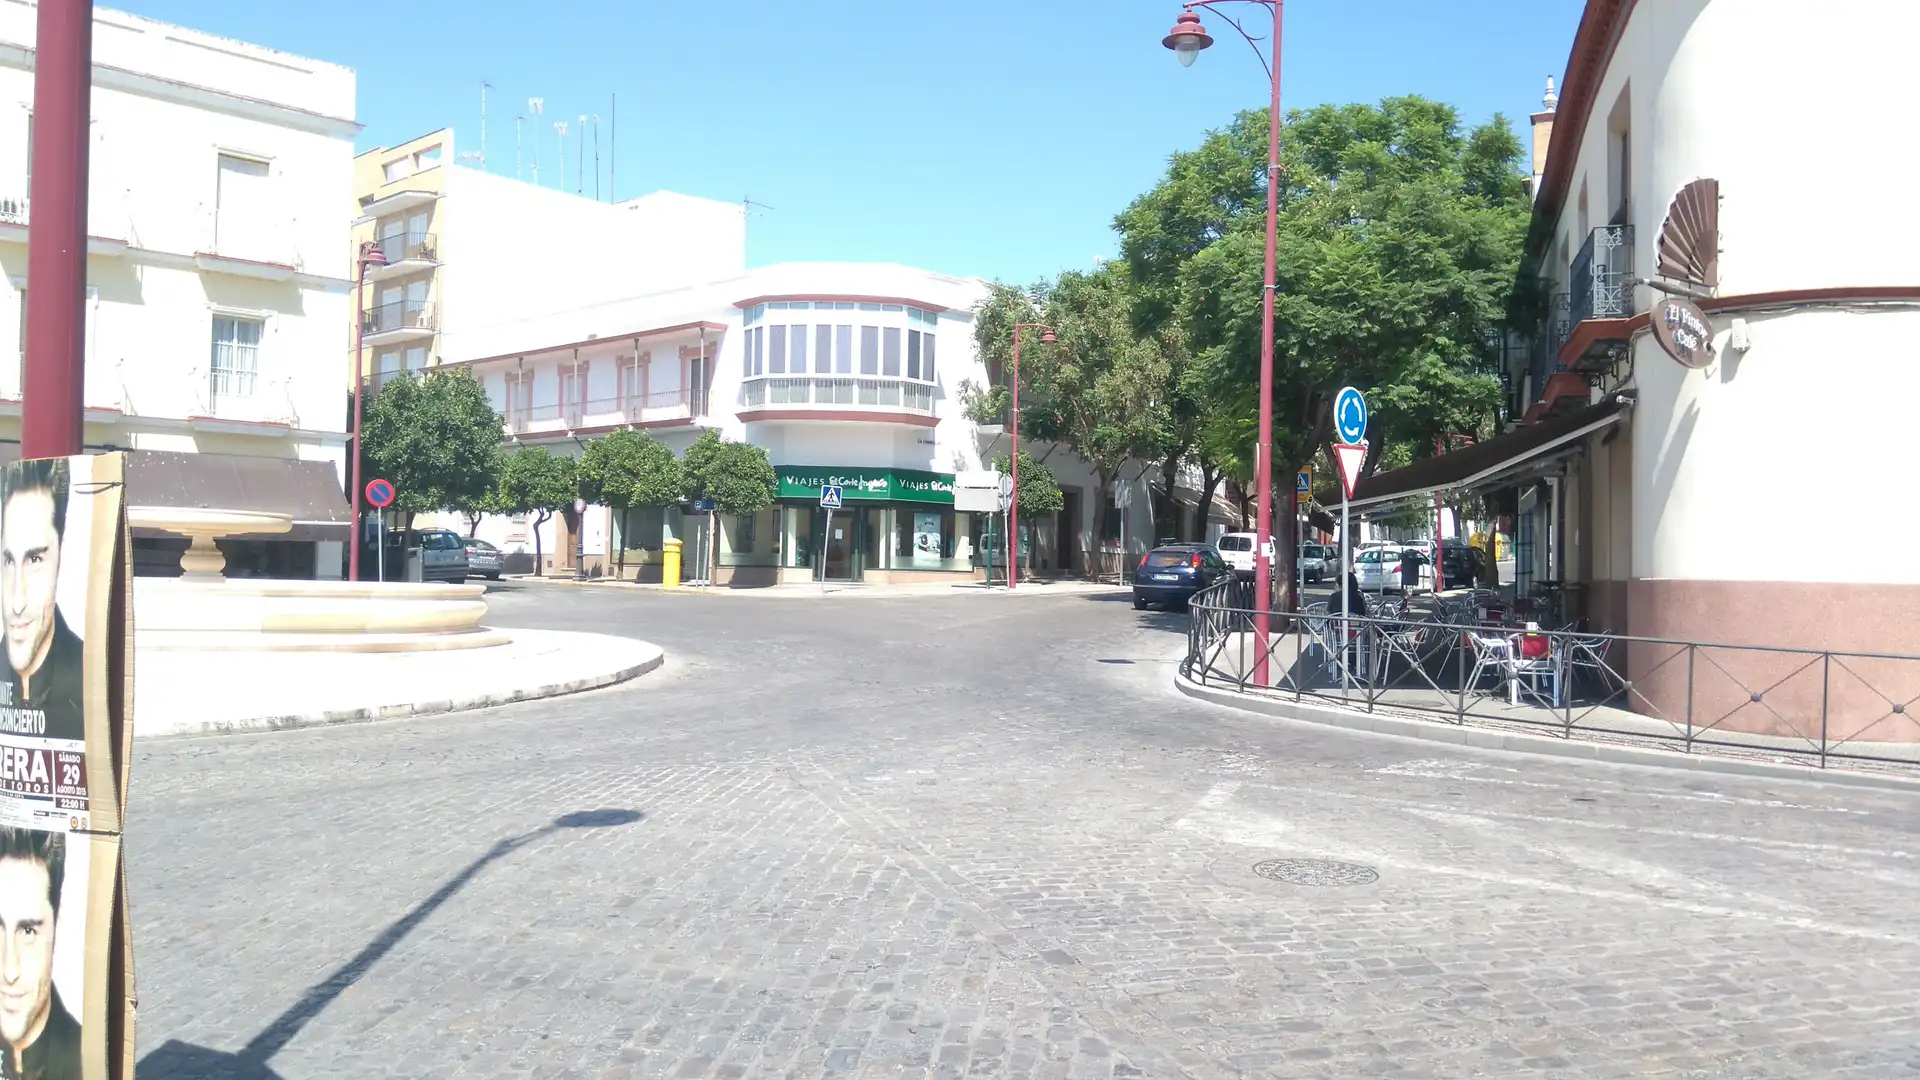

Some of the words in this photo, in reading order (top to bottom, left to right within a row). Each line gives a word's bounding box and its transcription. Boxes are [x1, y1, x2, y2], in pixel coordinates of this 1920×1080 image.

[786, 475, 825, 487] VIAJES
[899, 478, 929, 491] VIAJES
[63, 763, 81, 785] 29
[11, 780, 50, 794] TOROS
[80, 800, 85, 810] H
